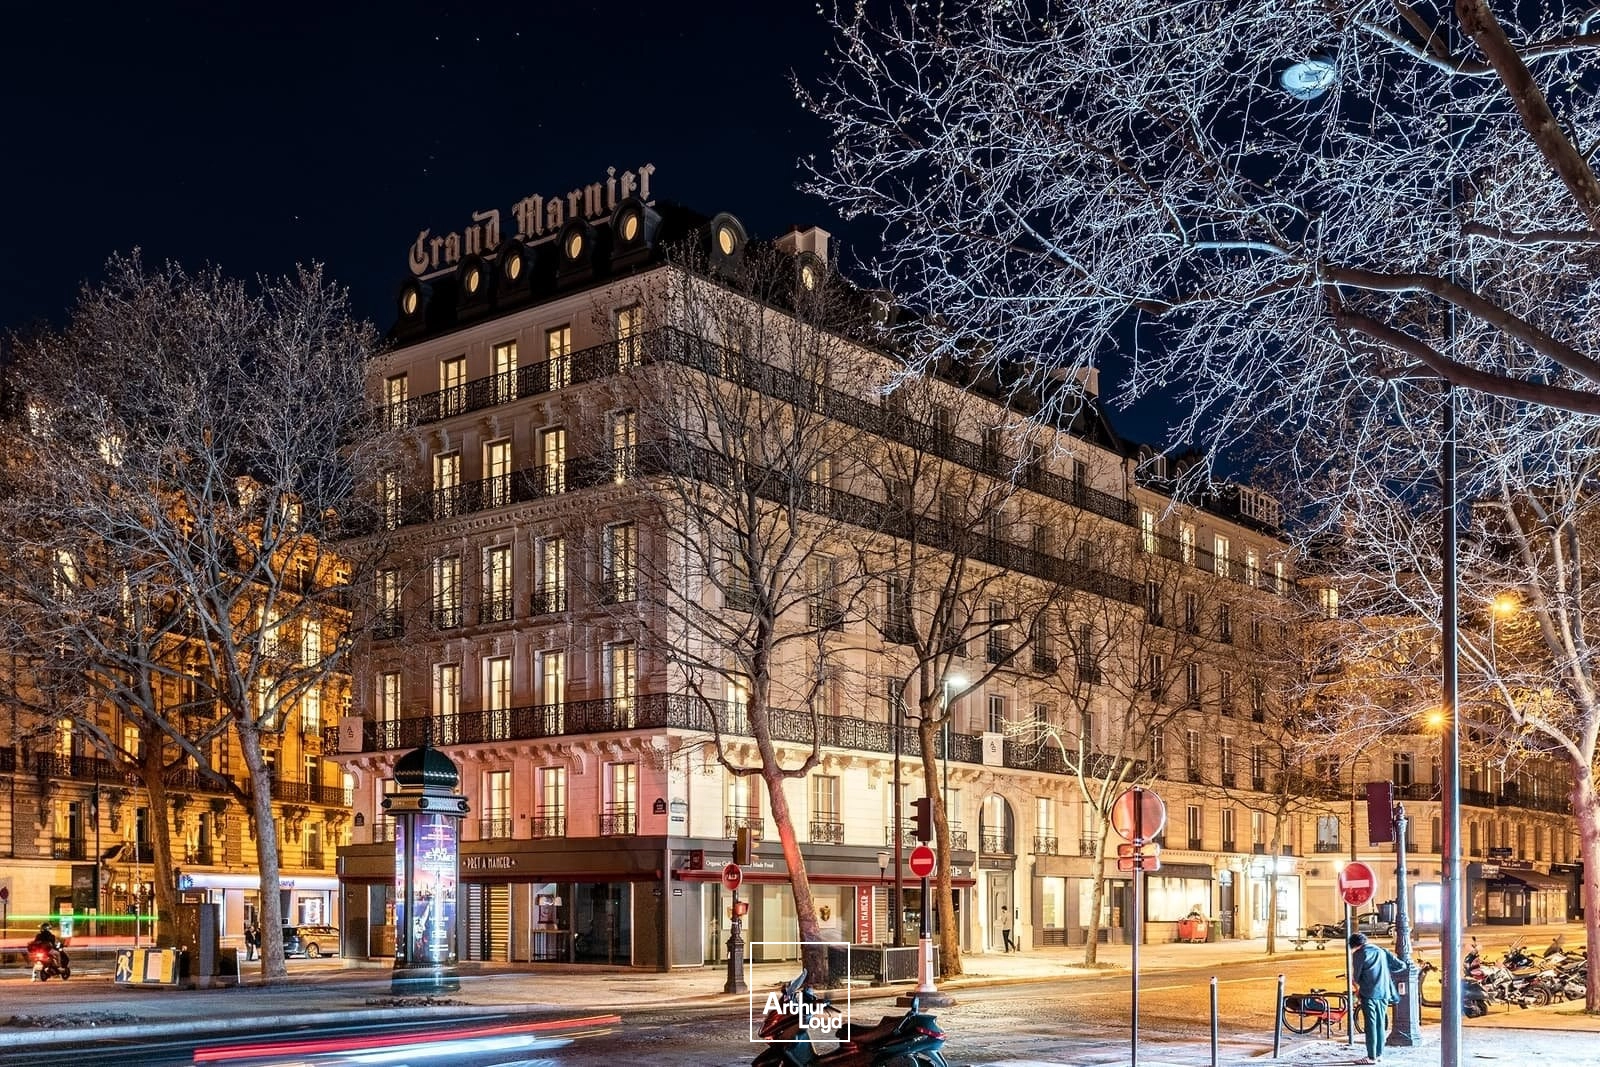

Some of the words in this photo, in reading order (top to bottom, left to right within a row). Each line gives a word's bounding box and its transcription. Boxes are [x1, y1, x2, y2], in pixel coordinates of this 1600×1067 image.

[408, 208, 501, 276] Grand
[511, 162, 656, 240] Marnier
[487, 855, 511, 869] MANGER
